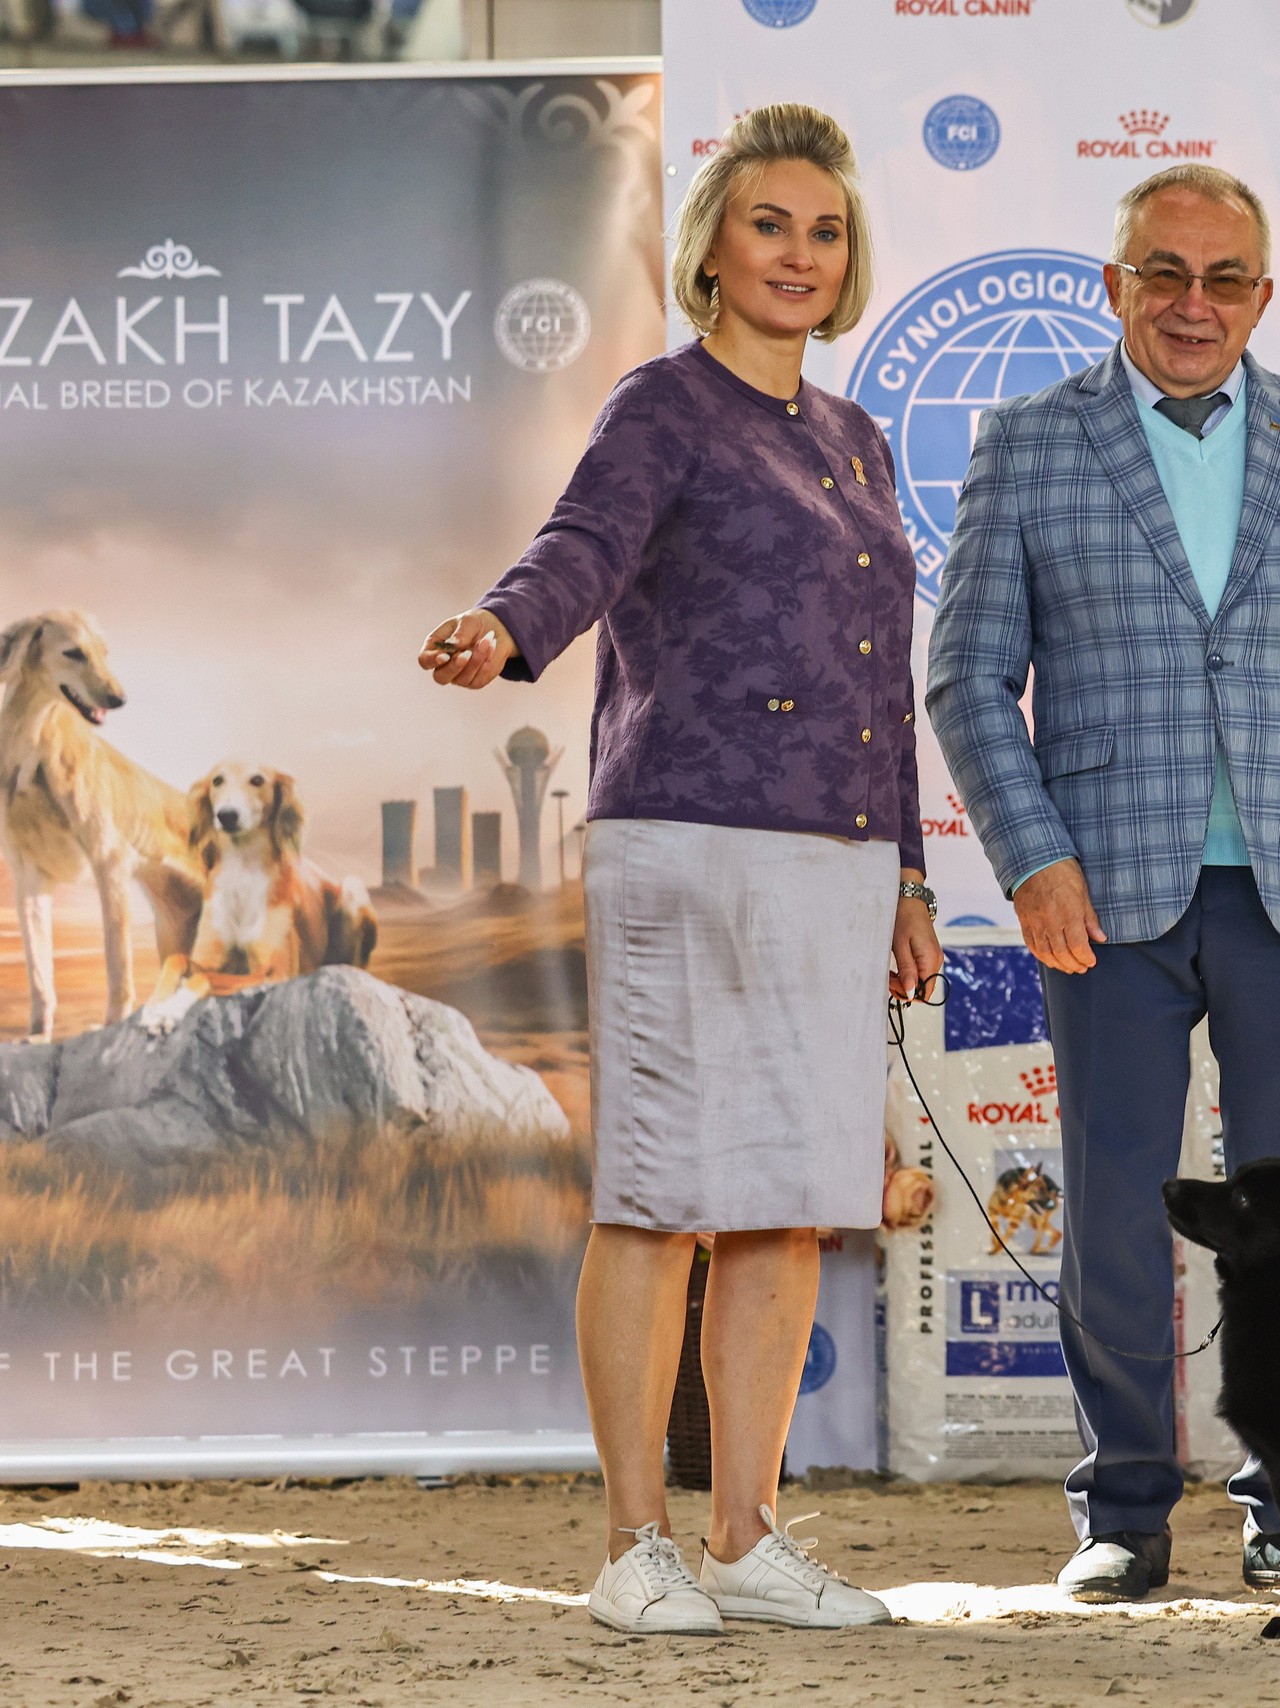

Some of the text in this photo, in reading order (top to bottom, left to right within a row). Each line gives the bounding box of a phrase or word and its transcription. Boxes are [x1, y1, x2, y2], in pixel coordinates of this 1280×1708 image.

[895, 0, 1032, 17] ROYAL CANIN
[947, 124, 978, 141] FCI
[1076, 140, 1214, 159] ROYAL CANIN
[262, 289, 473, 364] TAZY
[521, 316, 561, 334] FCI
[59, 379, 172, 410] BREED
[182, 377, 233, 410] OF
[244, 374, 472, 408] KAZAKHSTAN
[920, 819, 970, 837] OYAL
[967, 1101, 1050, 1126] ROYAL
[920, 1140, 934, 1334] PROFESSAL
[43, 1351, 132, 1382] THE
[165, 1347, 336, 1381] GREAT
[368, 1343, 551, 1378] STEPPE
